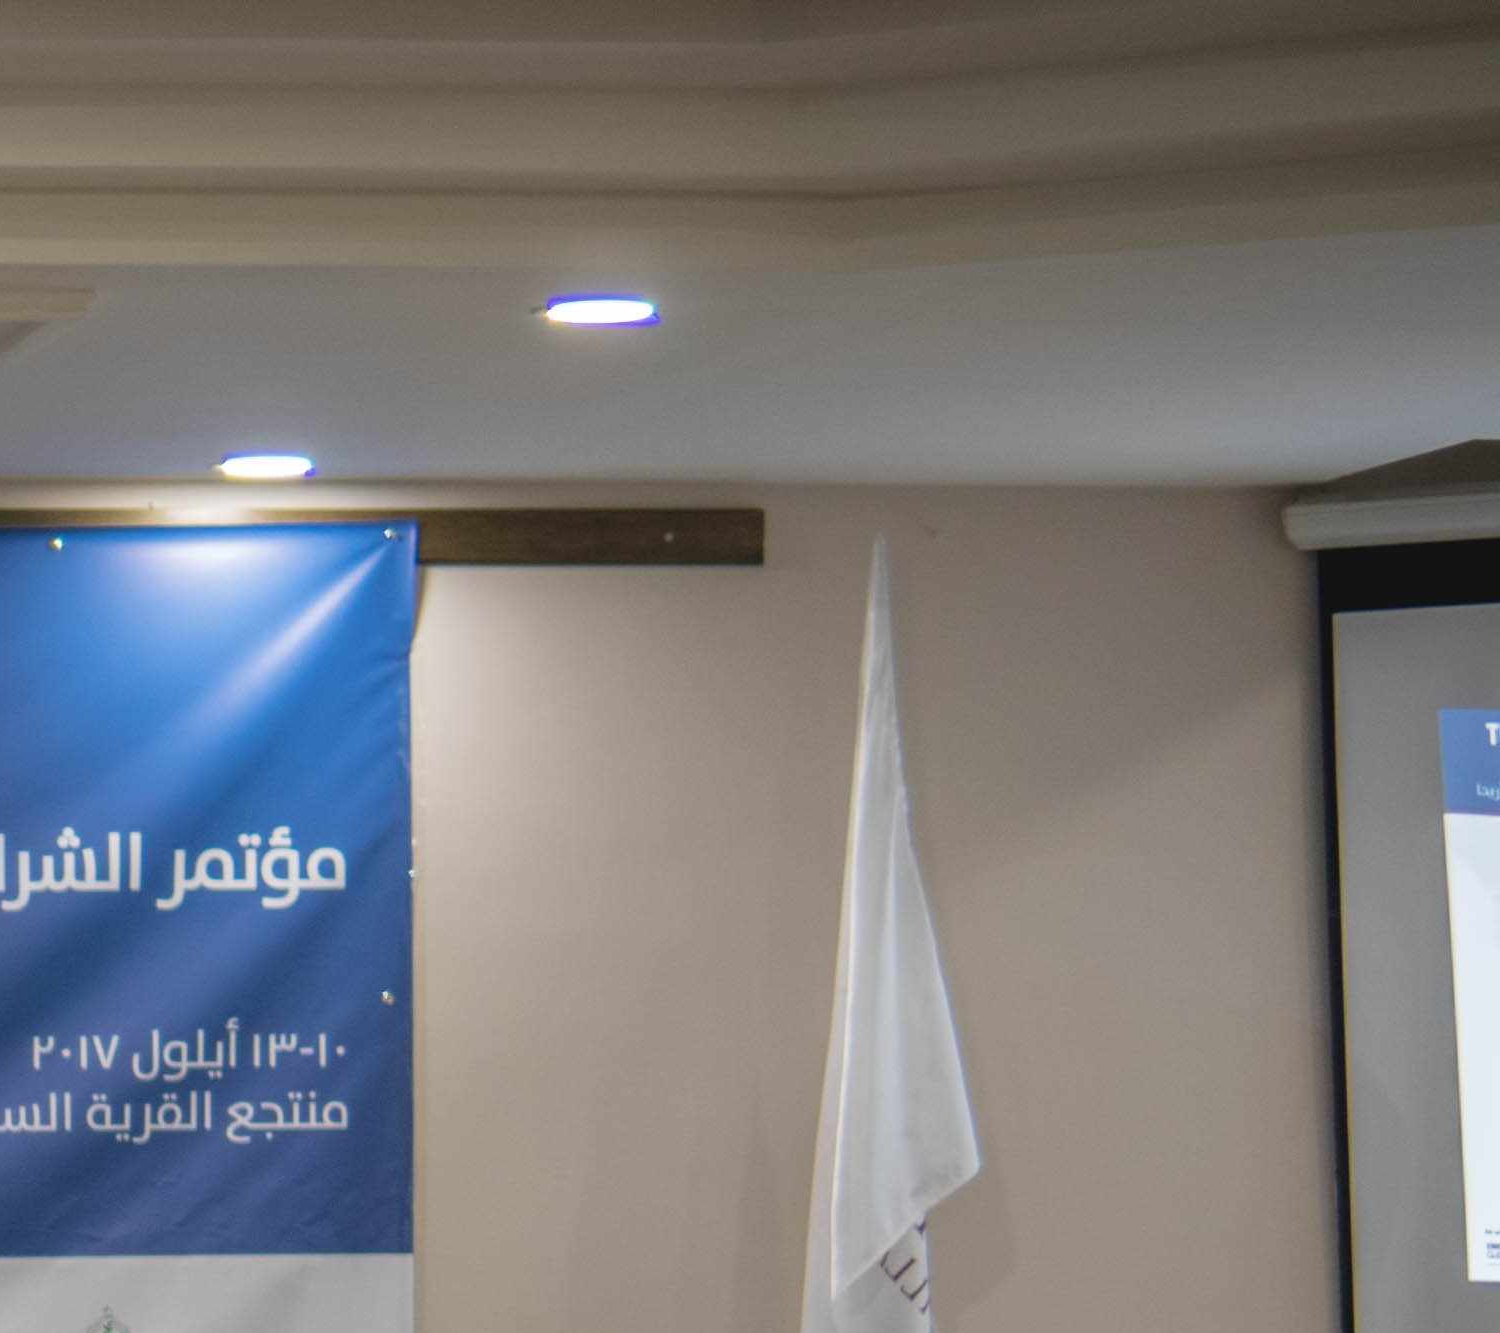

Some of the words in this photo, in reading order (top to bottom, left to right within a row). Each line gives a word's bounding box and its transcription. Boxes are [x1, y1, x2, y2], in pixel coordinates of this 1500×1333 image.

[156, 825, 346, 910] مؤتمر
[32, 1034, 120, 1070] ٢٠١٧
[131, 1017, 239, 1082] أيلول
[85, 1090, 213, 1144] القرية
[225, 1091, 348, 1144] منتجع
